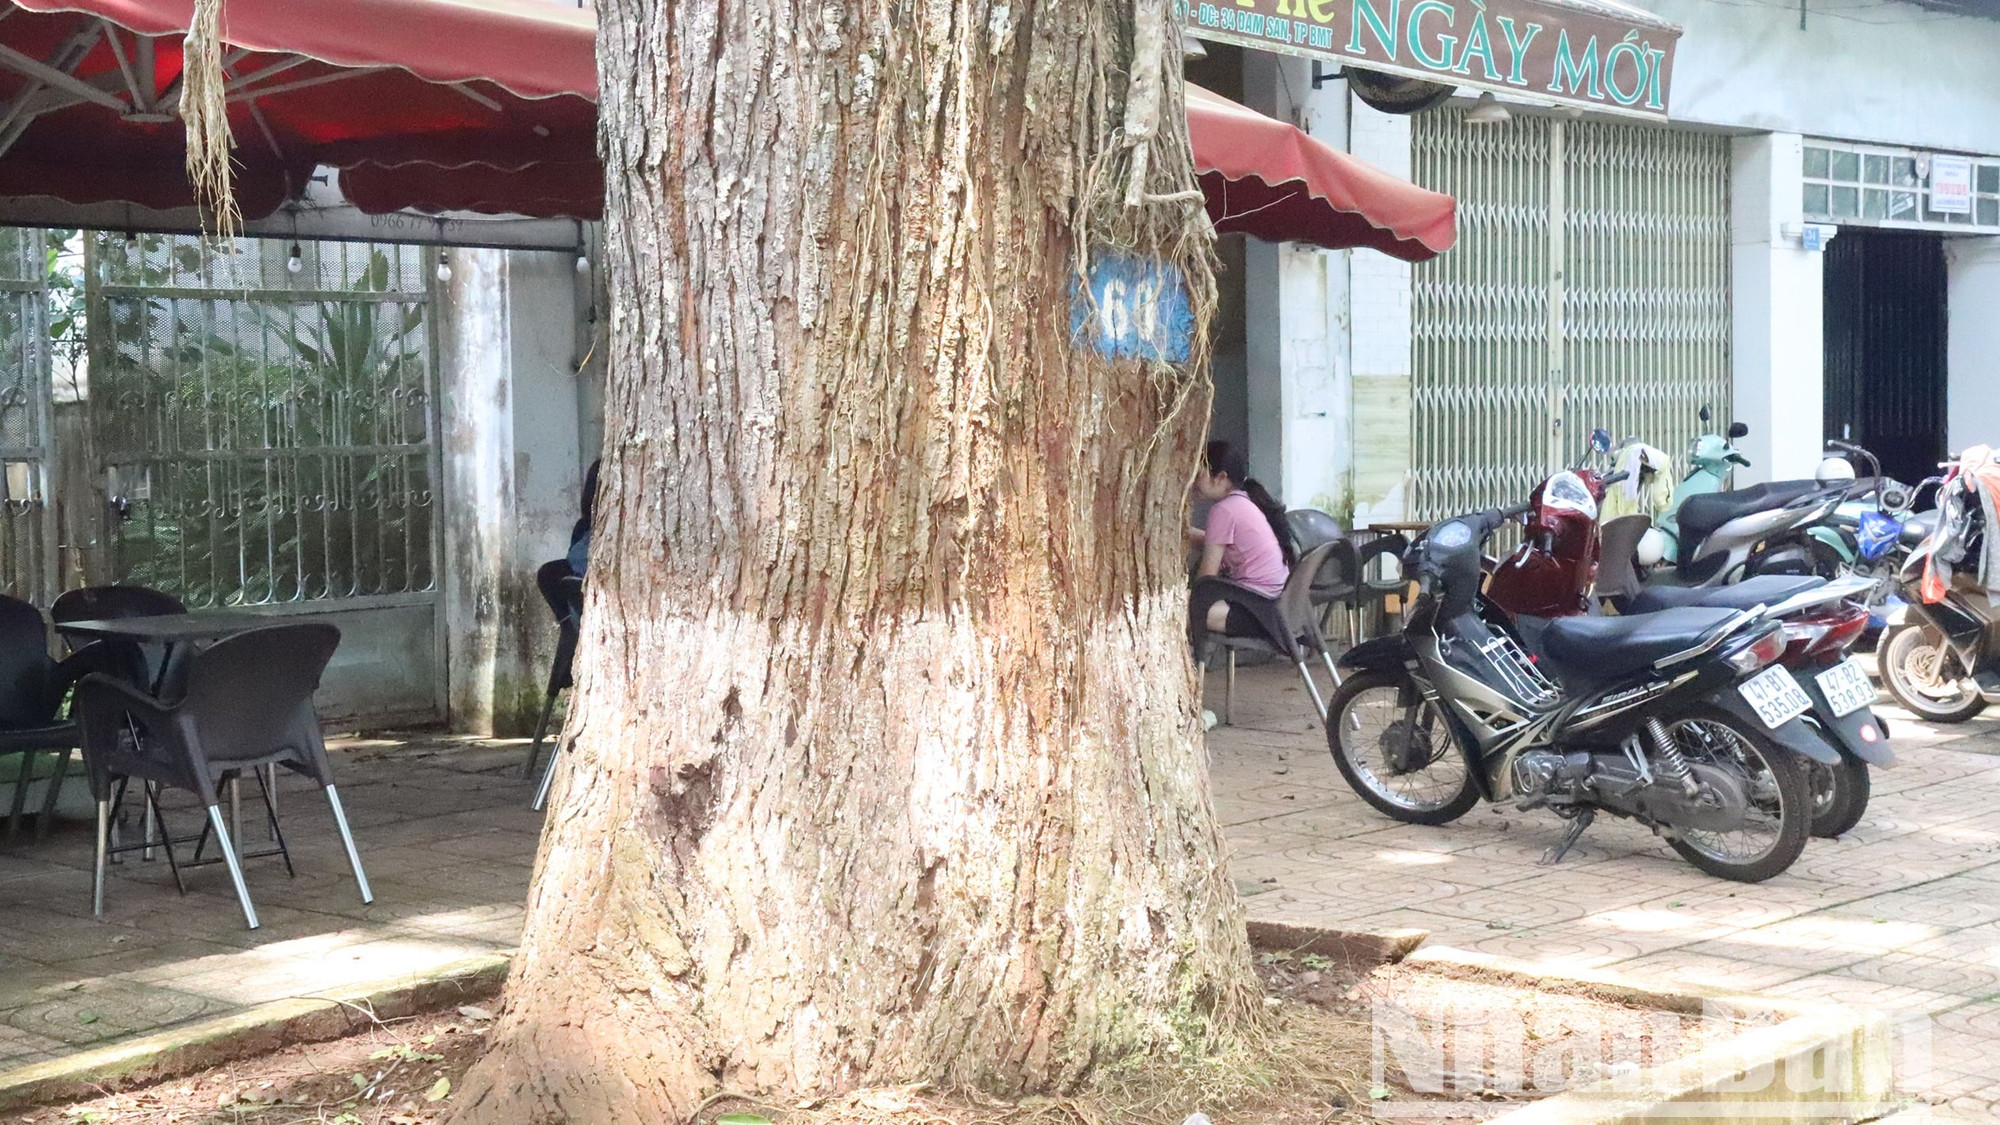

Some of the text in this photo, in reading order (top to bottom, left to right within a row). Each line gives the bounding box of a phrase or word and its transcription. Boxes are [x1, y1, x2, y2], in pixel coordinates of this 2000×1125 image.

[1220, 8, 1235, 30] 34
[1266, 16, 1292, 44] SAN,
[1294, 21, 1308, 43] TP
[1309, 25, 1333, 49] BMT
[1345, 0, 1665, 110] NGÀY MỚI
